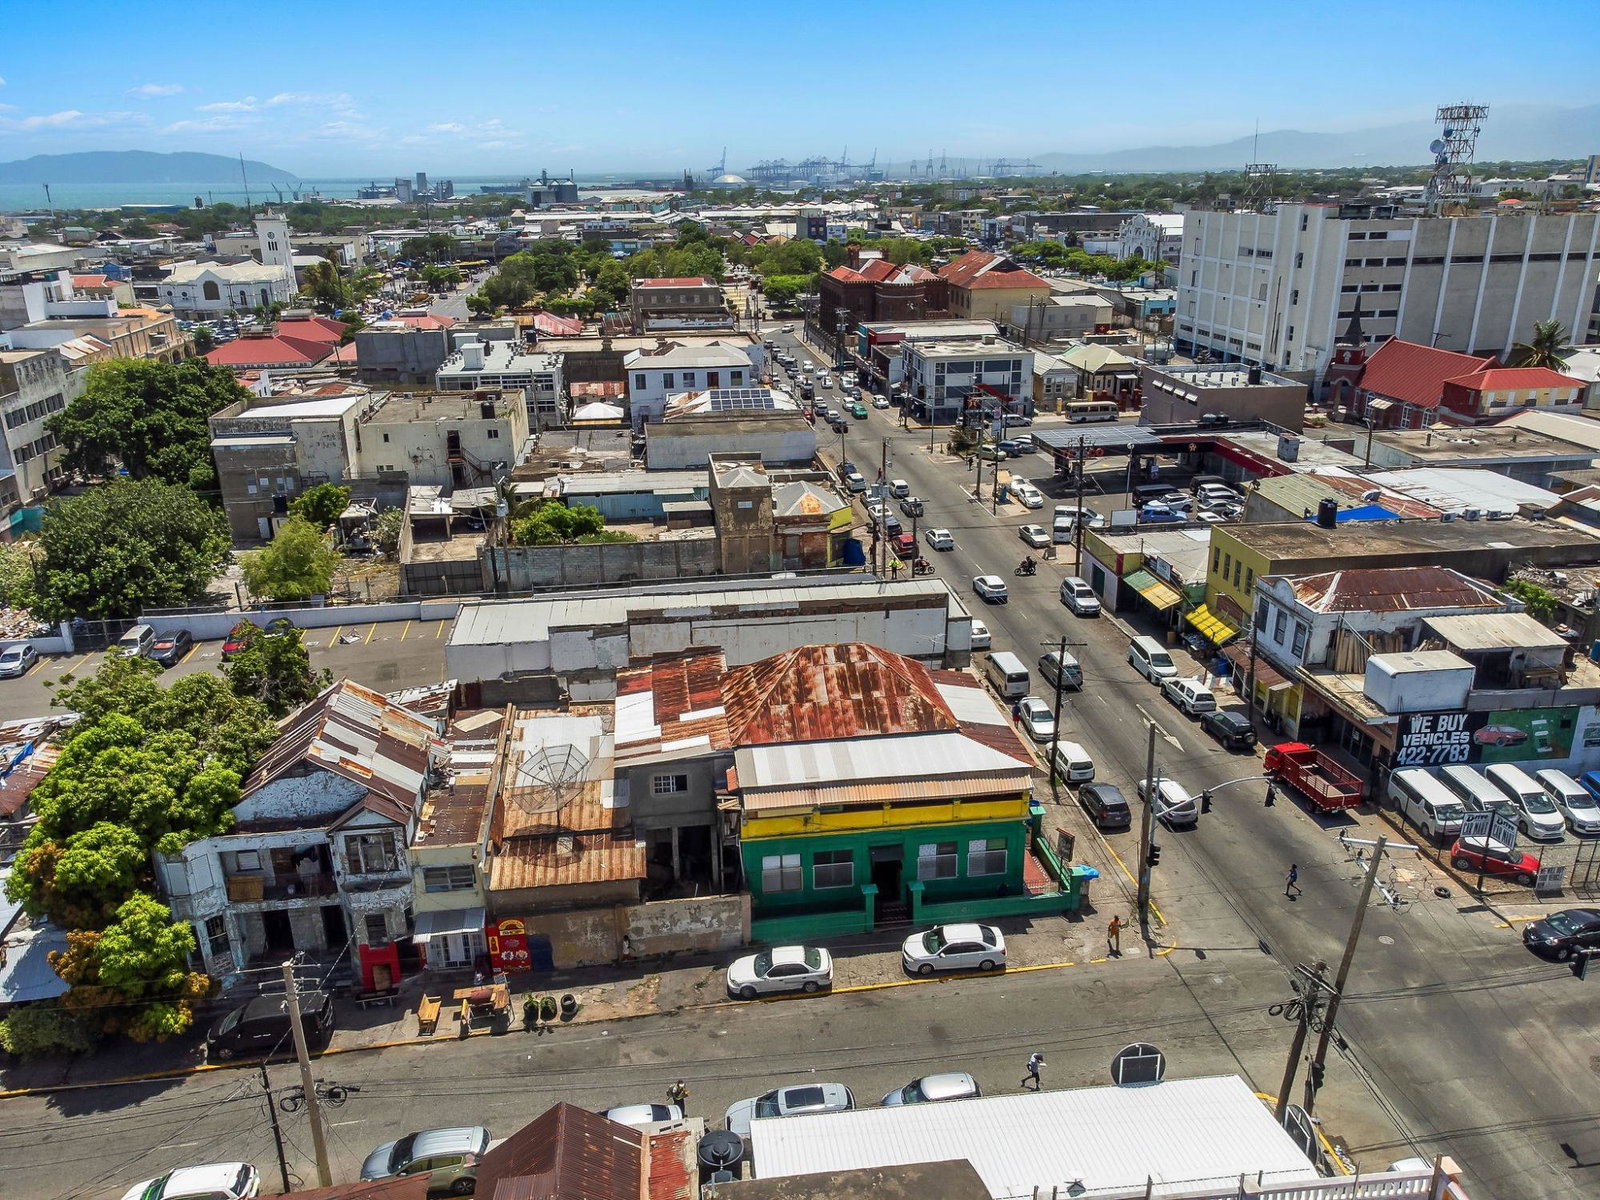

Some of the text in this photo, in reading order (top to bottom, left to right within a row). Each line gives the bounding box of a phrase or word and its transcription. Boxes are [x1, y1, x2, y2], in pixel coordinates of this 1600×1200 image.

[1411, 714, 1468, 733] WE BUY
[1403, 731, 1470, 746] VEHICLES
[1397, 744, 1470, 764] 422-7783
